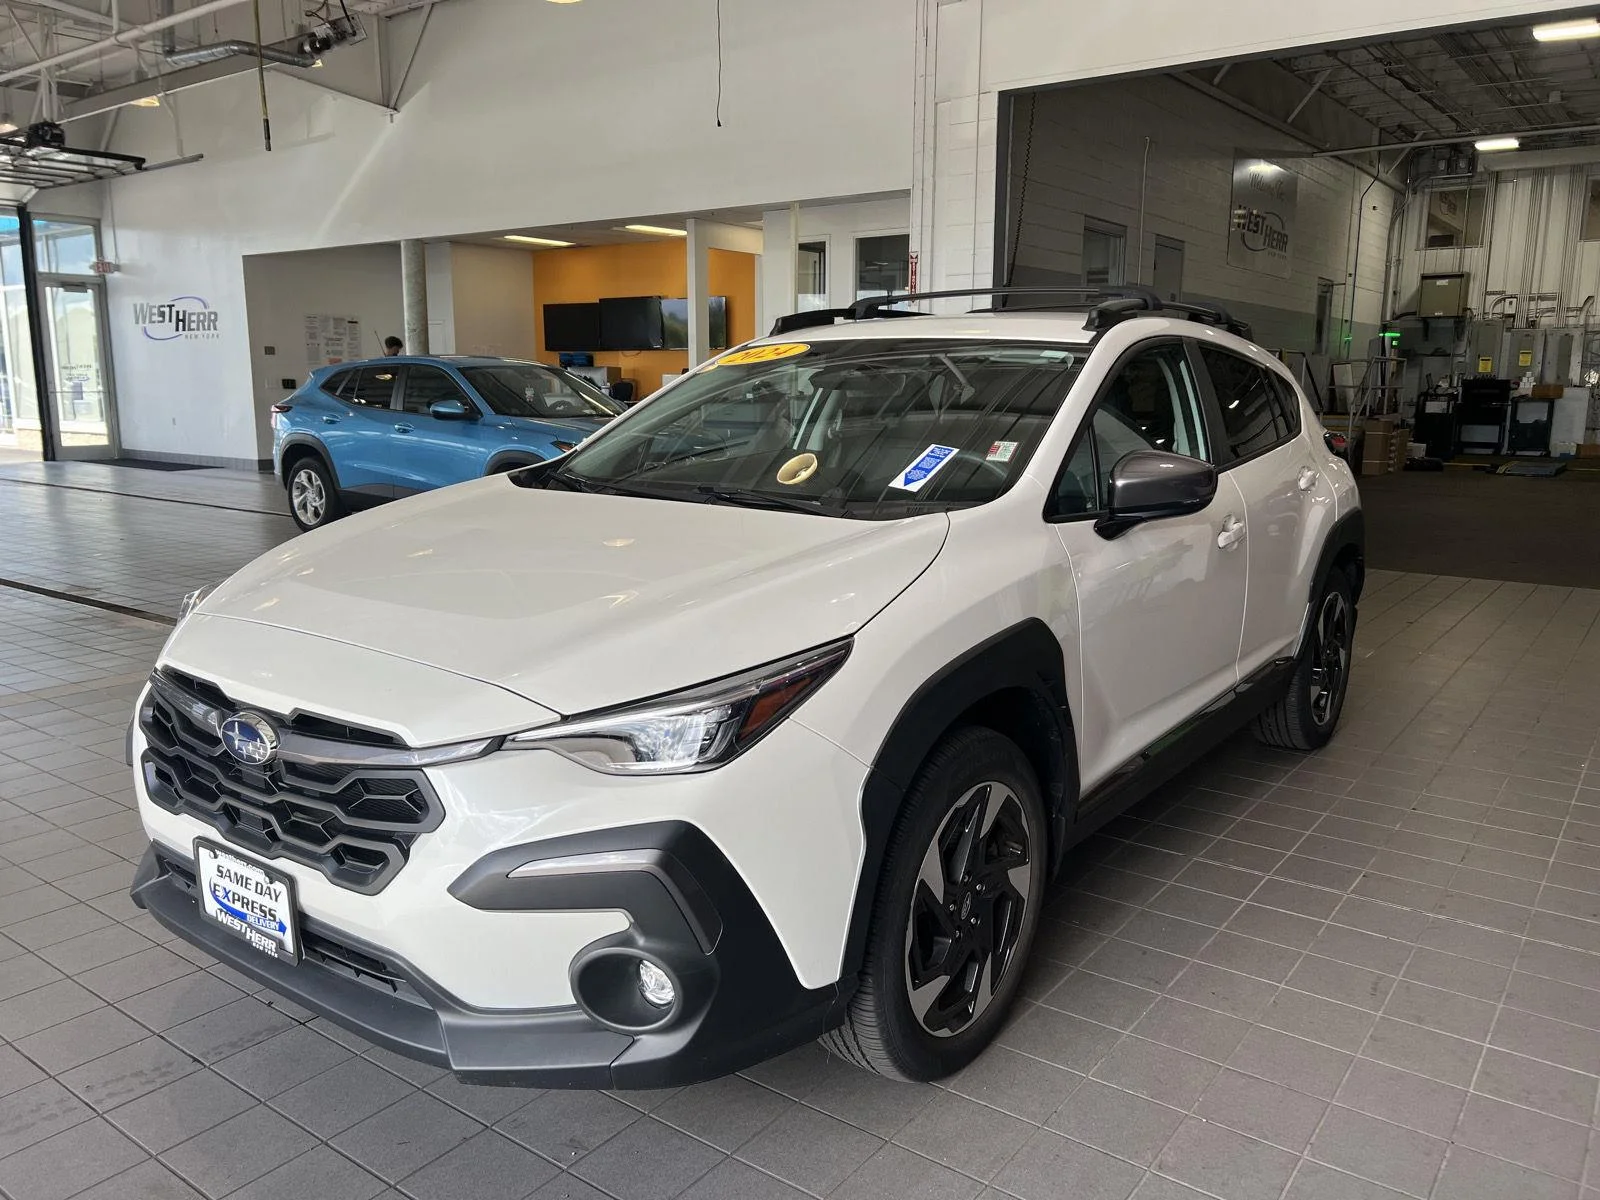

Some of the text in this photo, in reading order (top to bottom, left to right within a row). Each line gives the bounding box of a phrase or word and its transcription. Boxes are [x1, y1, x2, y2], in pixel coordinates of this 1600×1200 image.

[1237, 204, 1266, 236] WEST
[1263, 224, 1289, 253] HERR
[133, 303, 175, 324] WEST
[175, 309, 218, 332] HERR
[725, 344, 800, 362] 2024
[216, 864, 282, 903] SAME DAY
[213, 883, 277, 921] EXPRESS
[216, 908, 248, 933] WEST
[247, 914, 280, 931] DELIVERY
[246, 928, 277, 953] HERR
